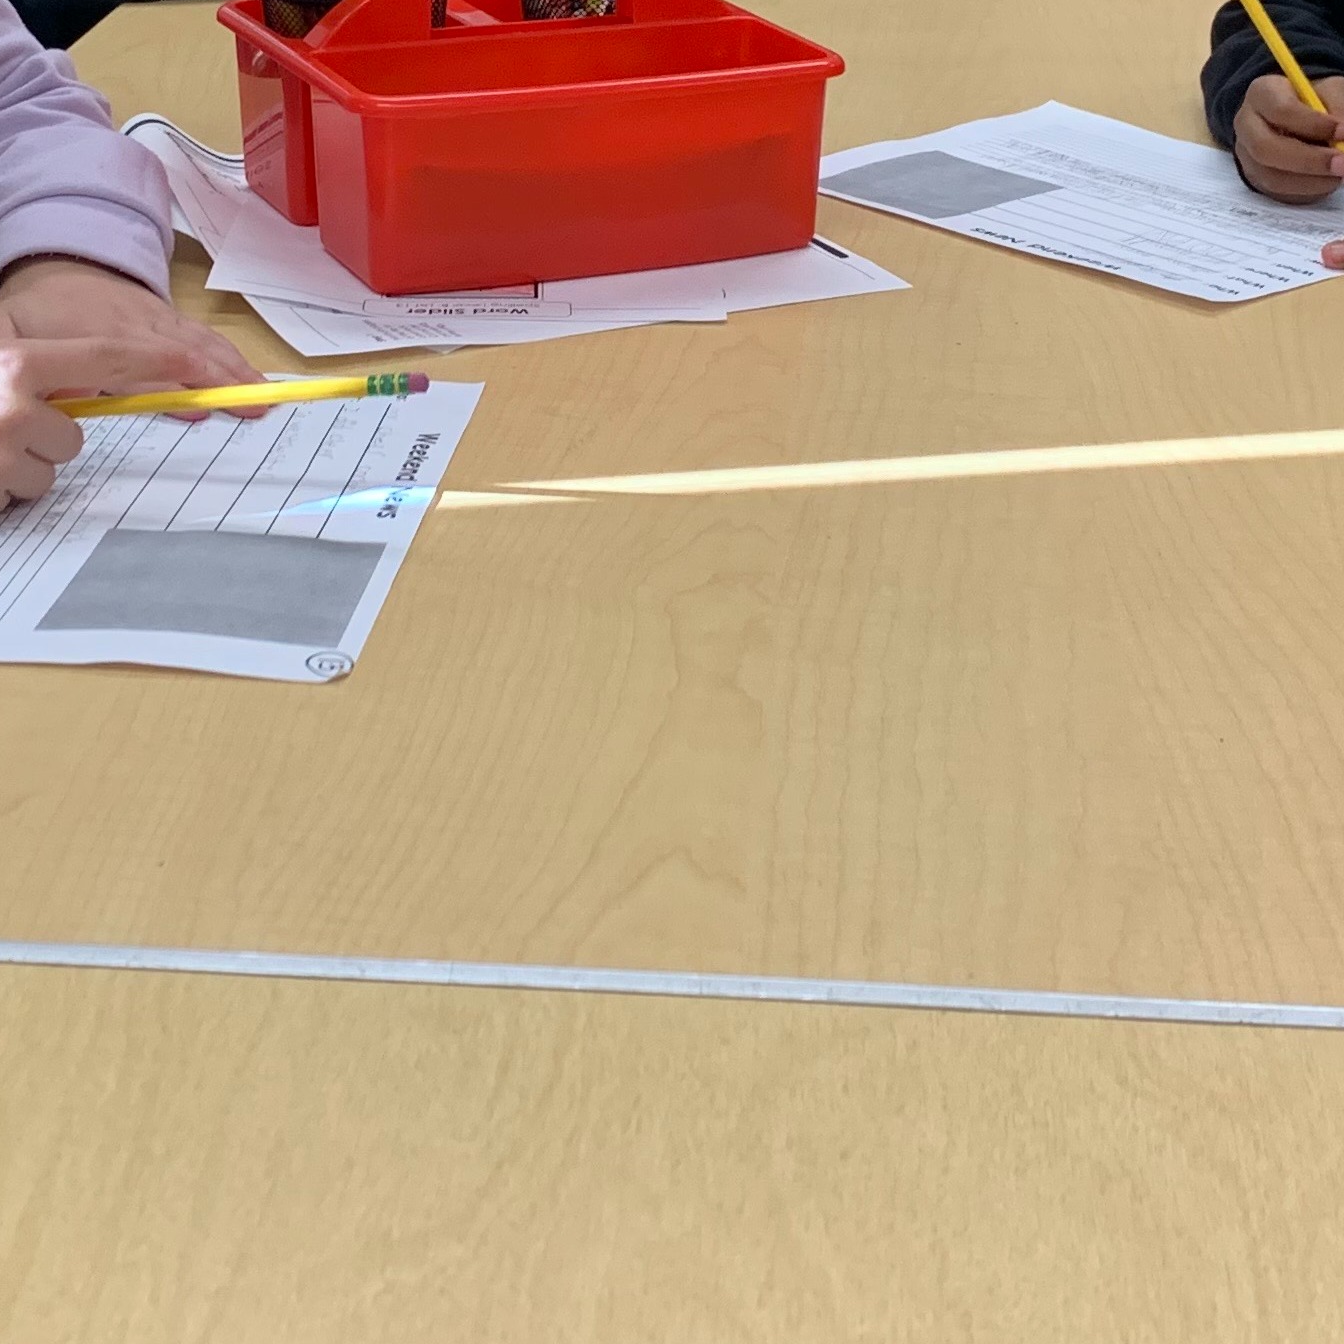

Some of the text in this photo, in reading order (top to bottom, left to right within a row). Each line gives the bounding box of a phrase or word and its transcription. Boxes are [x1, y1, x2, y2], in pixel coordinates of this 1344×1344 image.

[405, 307, 530, 315] Word Slider
[395, 432, 442, 483] Weekend
